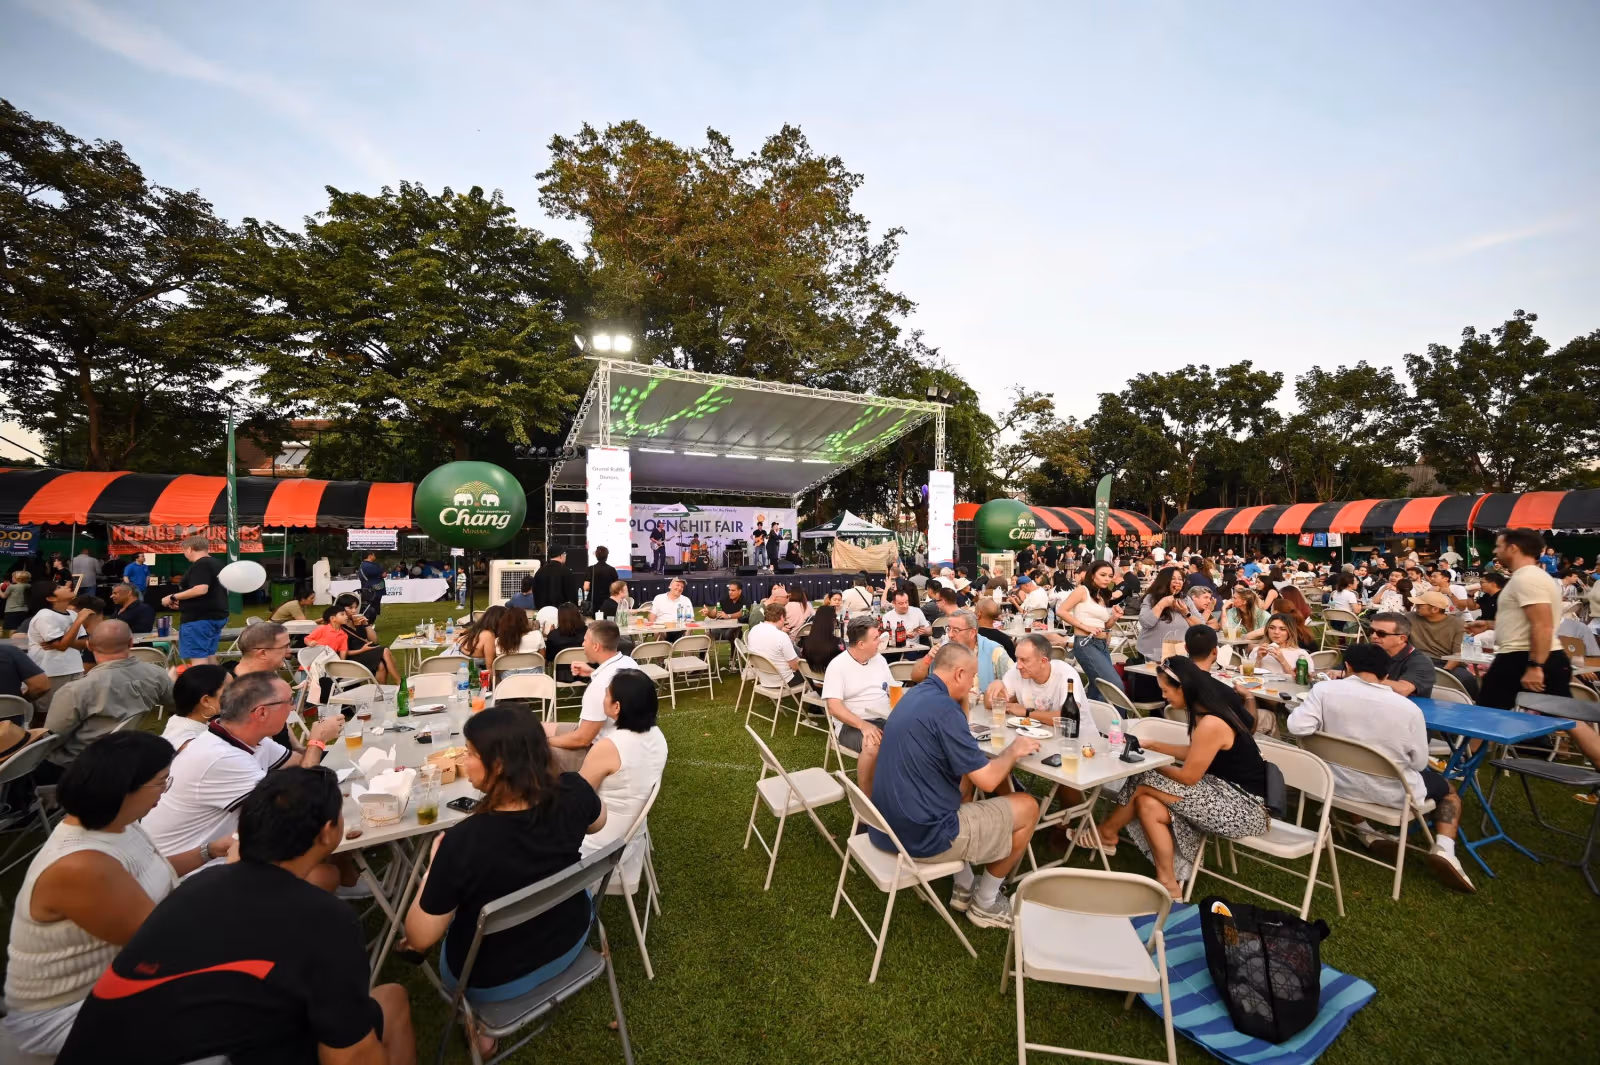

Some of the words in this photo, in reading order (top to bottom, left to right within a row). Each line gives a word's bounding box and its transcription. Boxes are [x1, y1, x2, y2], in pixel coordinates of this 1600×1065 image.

[439, 507, 511, 529] Chang
[630, 519, 711, 532] PLONCHIT
[715, 520, 744, 532] FAIR
[113, 524, 175, 540] KEBABS
[1009, 528, 1035, 540] Chan
[1096, 510, 1105, 551] Chang
